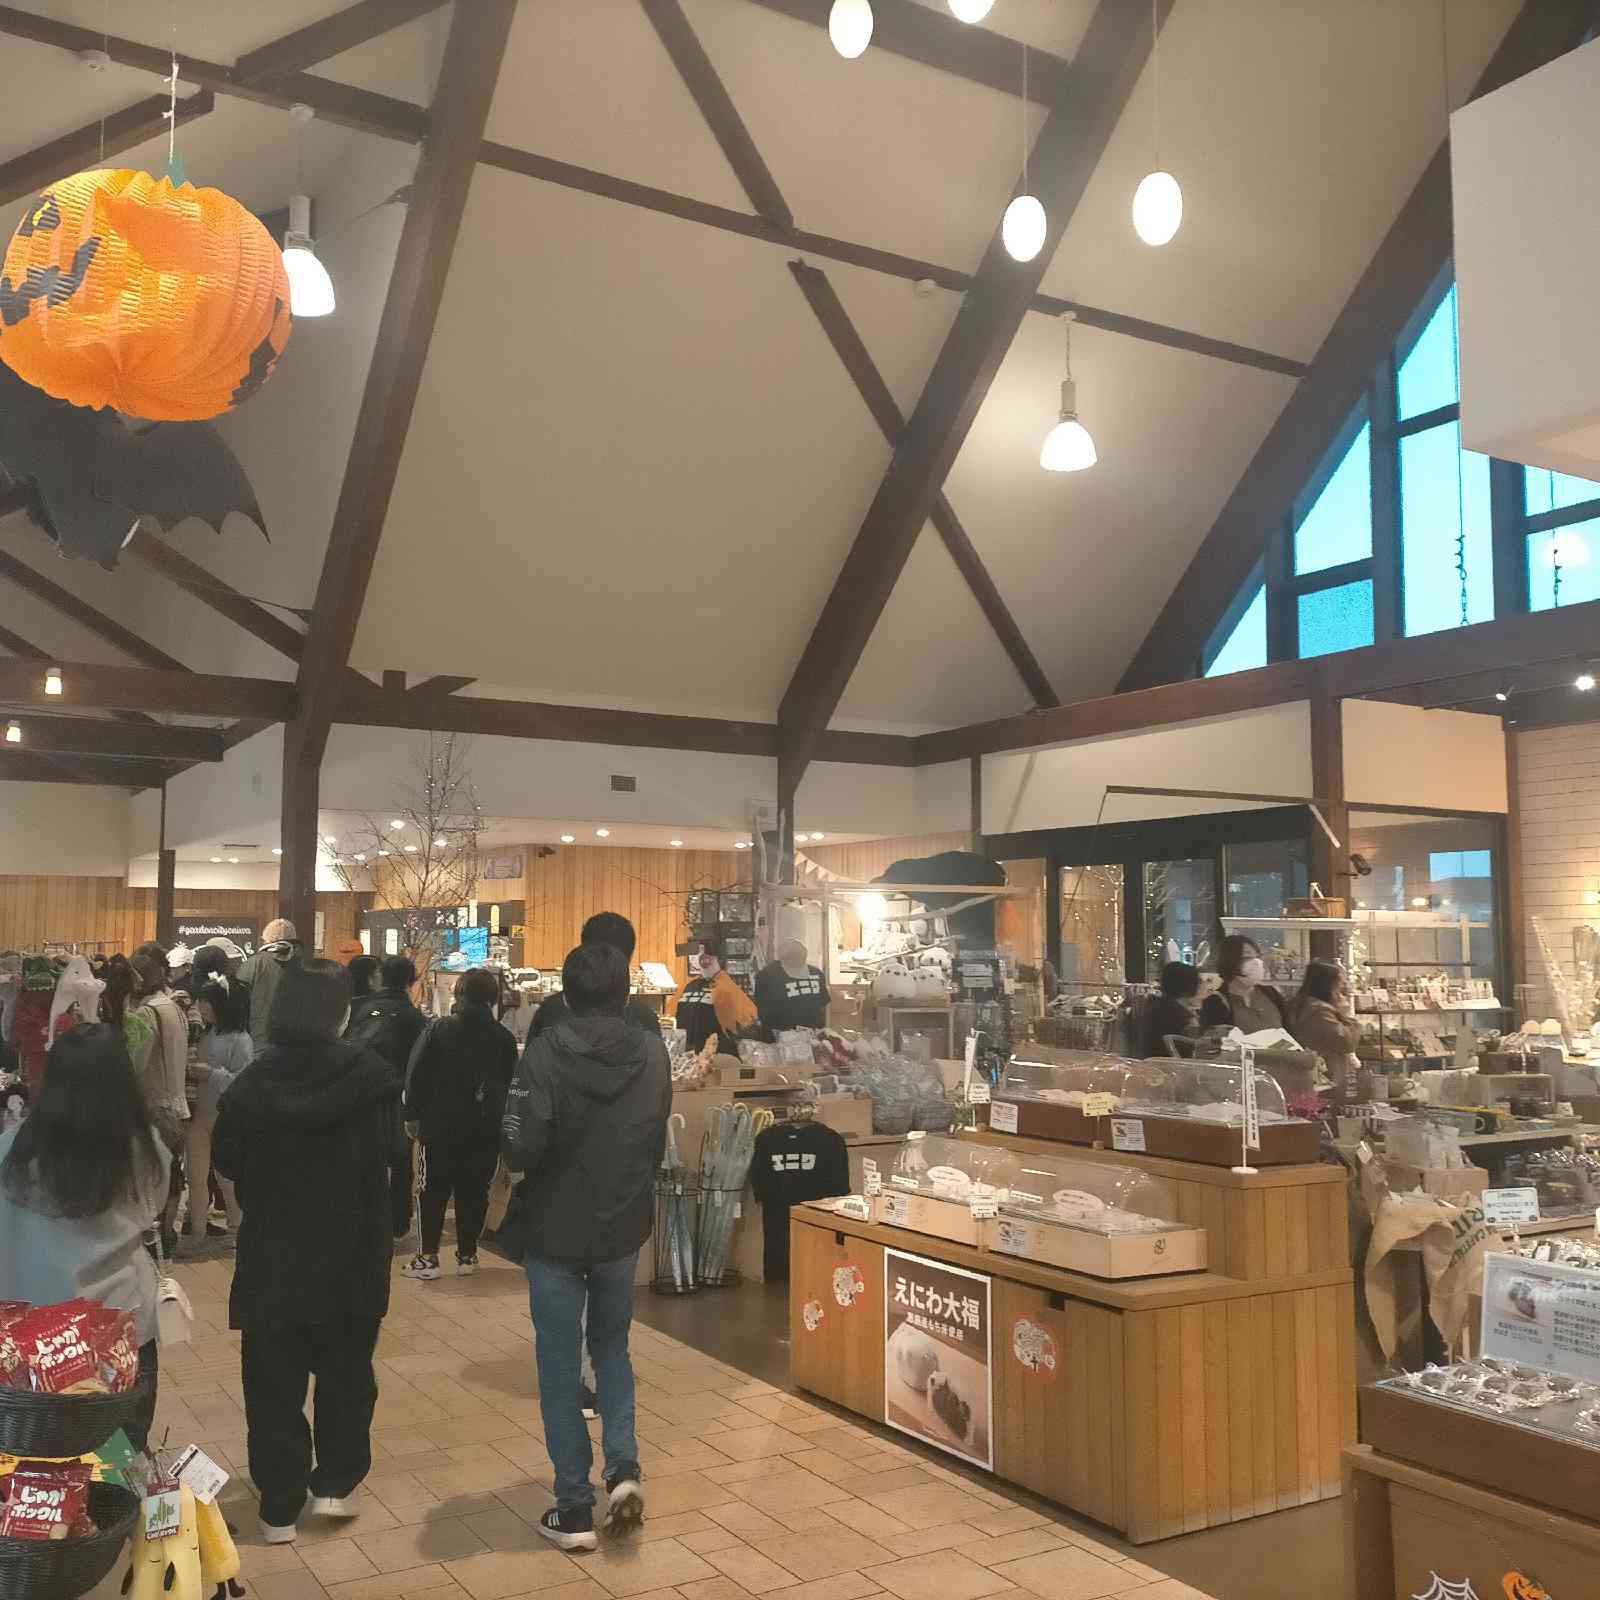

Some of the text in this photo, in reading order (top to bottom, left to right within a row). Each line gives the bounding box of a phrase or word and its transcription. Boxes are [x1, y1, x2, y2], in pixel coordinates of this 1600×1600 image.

[771, 1153, 817, 1172] エニワ
[894, 1276, 980, 1331] えにわ大福
[35, 1324, 81, 1355] じゃが
[40, 1340, 91, 1370] ポックル
[20, 1485, 68, 1507] じゃが
[11, 1503, 63, 1522] ポックル
